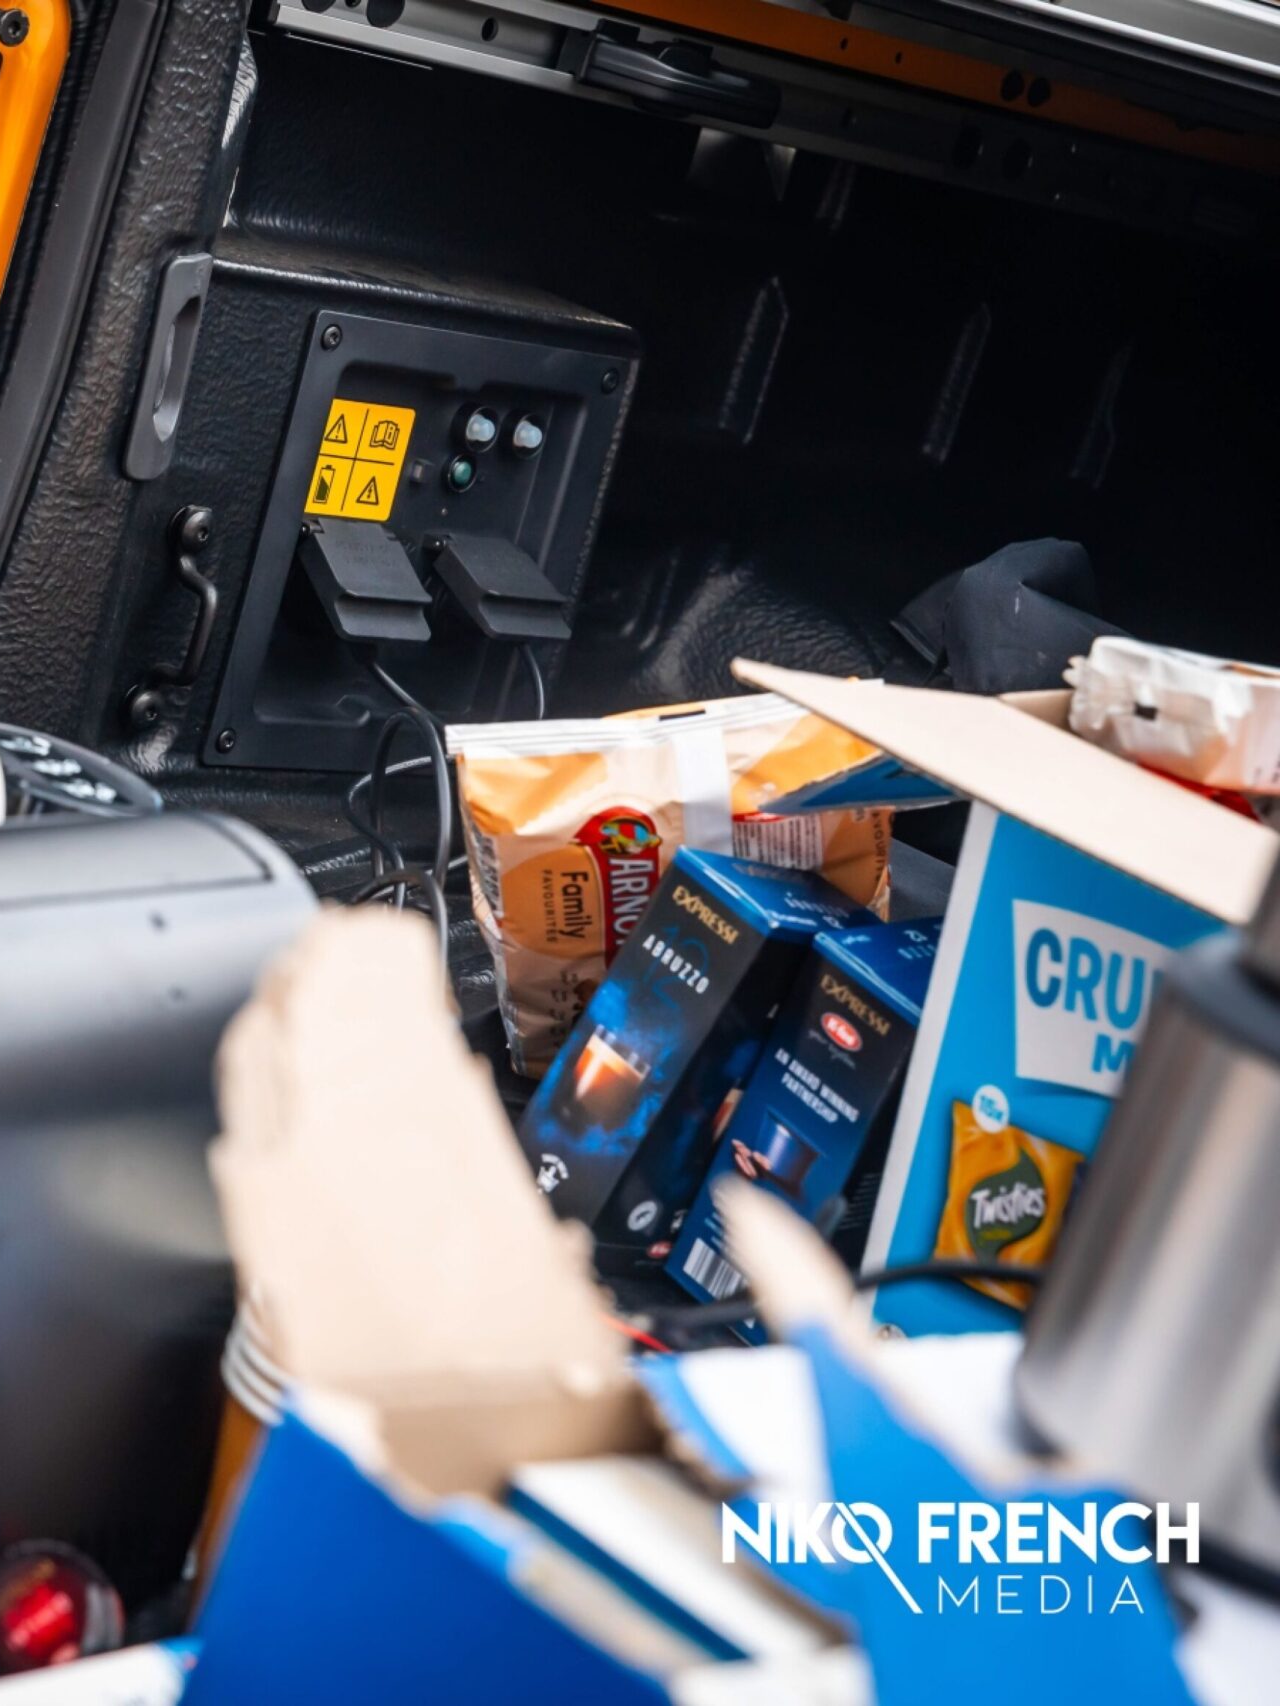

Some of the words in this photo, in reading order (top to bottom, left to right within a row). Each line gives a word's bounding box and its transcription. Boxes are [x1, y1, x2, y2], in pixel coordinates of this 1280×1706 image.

[561, 870, 593, 940] Family
[608, 856, 656, 944] ARNO
[672, 885, 739, 945] EXPRESSI
[642, 934, 710, 994] ABRUZZO
[1025, 927, 1163, 1030] CRU
[820, 974, 891, 1036] EXPRESSI
[774, 1048, 791, 1066] AN
[788, 1059, 821, 1091] AWARD
[820, 1083, 860, 1123] WINNING
[781, 1071, 839, 1123] PARTNERSHIP
[969, 1180, 1046, 1229] Twisties
